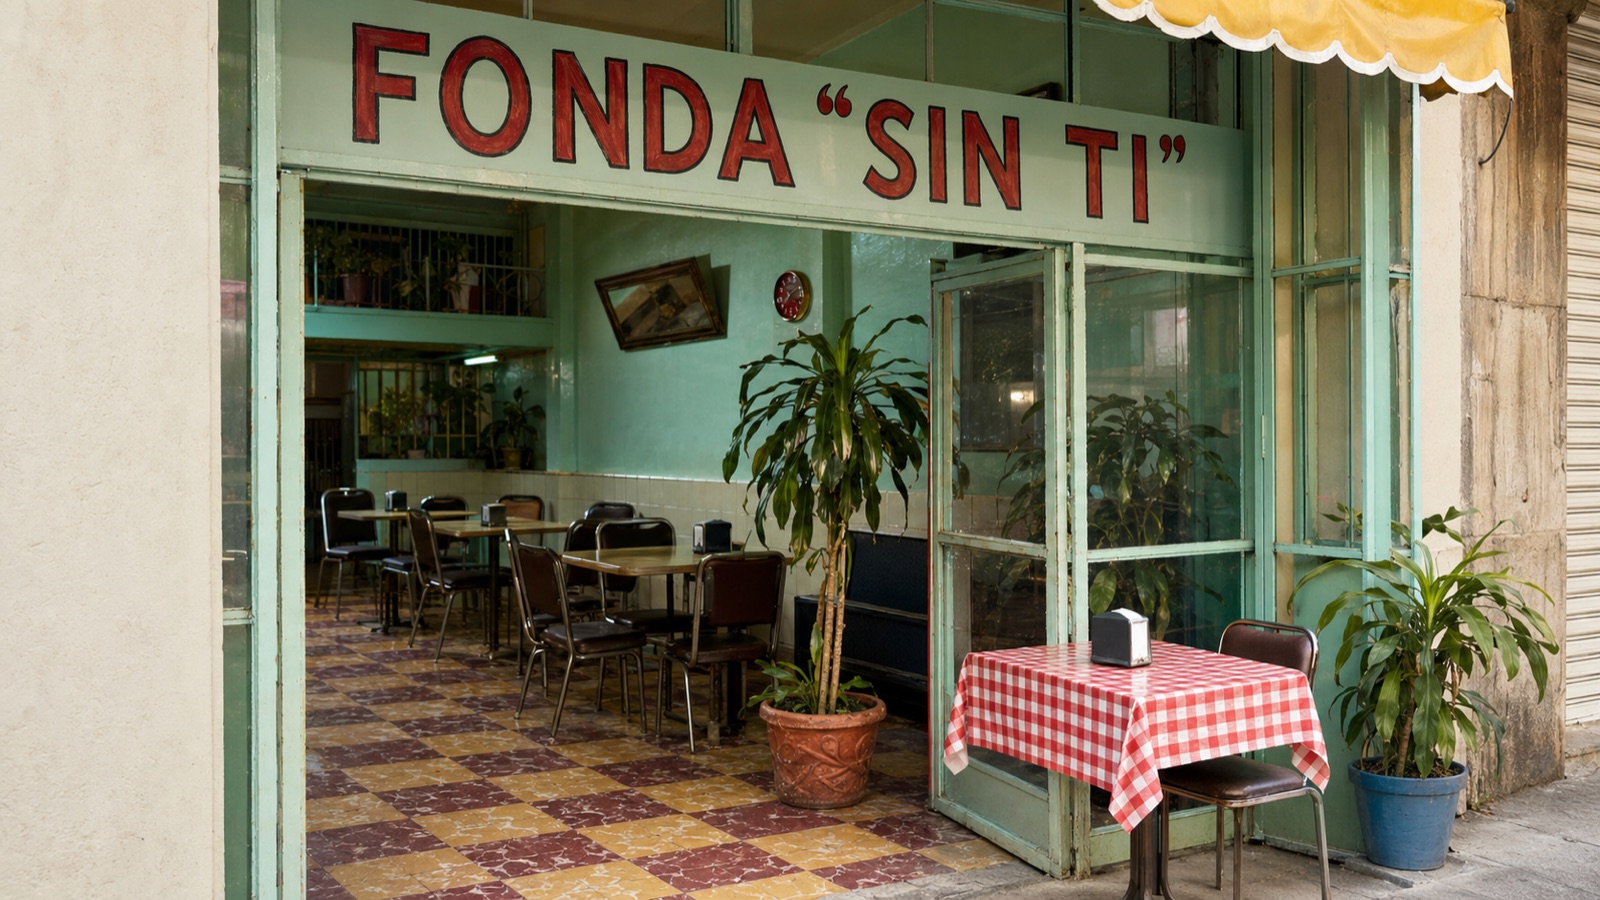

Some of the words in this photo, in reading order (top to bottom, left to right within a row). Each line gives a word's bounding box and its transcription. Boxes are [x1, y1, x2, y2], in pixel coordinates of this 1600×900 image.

[352, 22, 796, 187] FONDA
[816, 83, 1022, 211] “SIN
[1065, 124, 1186, 224] TI”
